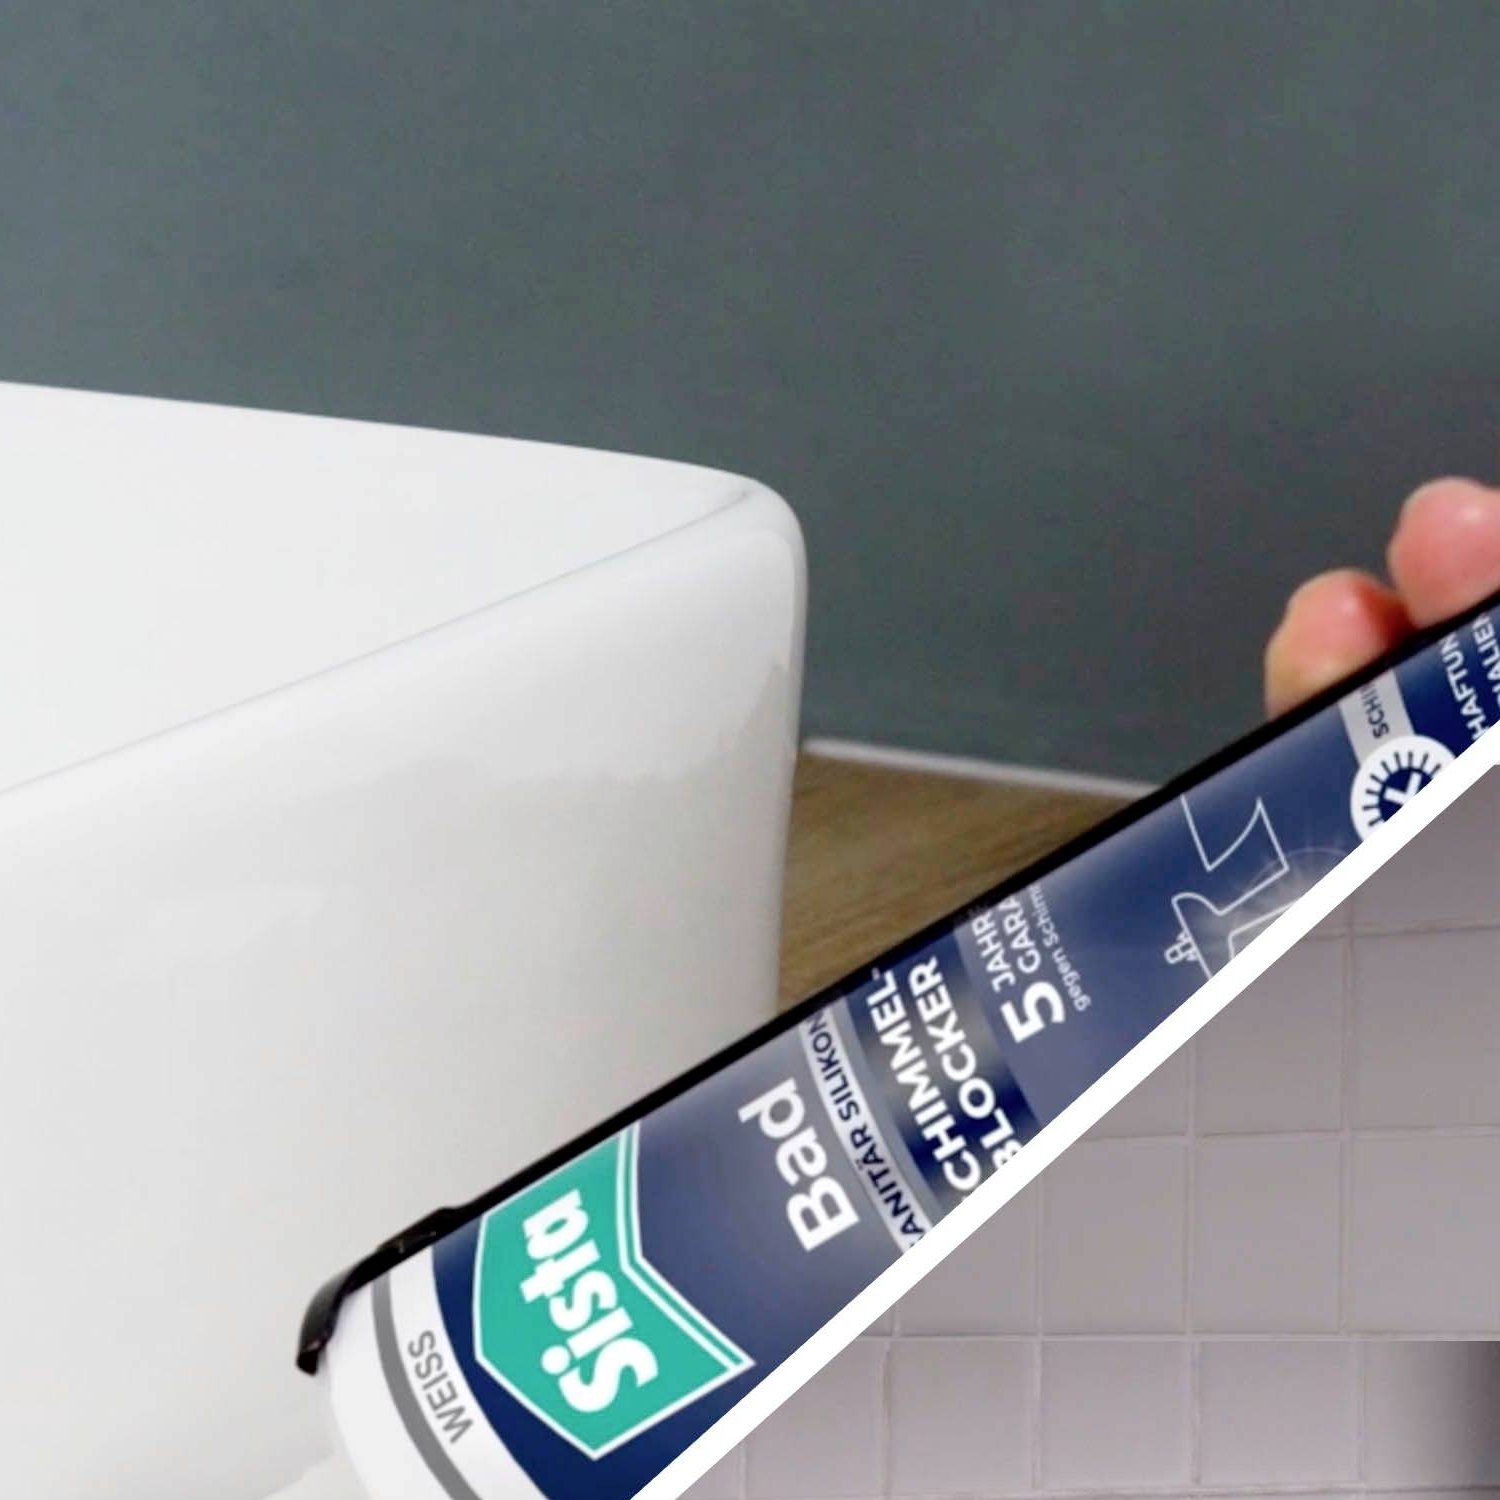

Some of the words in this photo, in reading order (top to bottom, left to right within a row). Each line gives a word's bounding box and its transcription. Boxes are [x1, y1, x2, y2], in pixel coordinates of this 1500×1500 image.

[1361, 685, 1390, 739] SCHI
[971, 907, 1016, 993] JAHR
[1052, 947, 1092, 1012] gegen
[908, 956, 1023, 1170] BLOCKER
[1000, 981, 1066, 1043] 5
[866, 967, 981, 1200] CHIMMEL-
[738, 1077, 860, 1252] Bad
[849, 1124, 925, 1248] ANITÄR
[519, 1188, 659, 1413] Sista
[407, 1330, 474, 1444] WEISS
